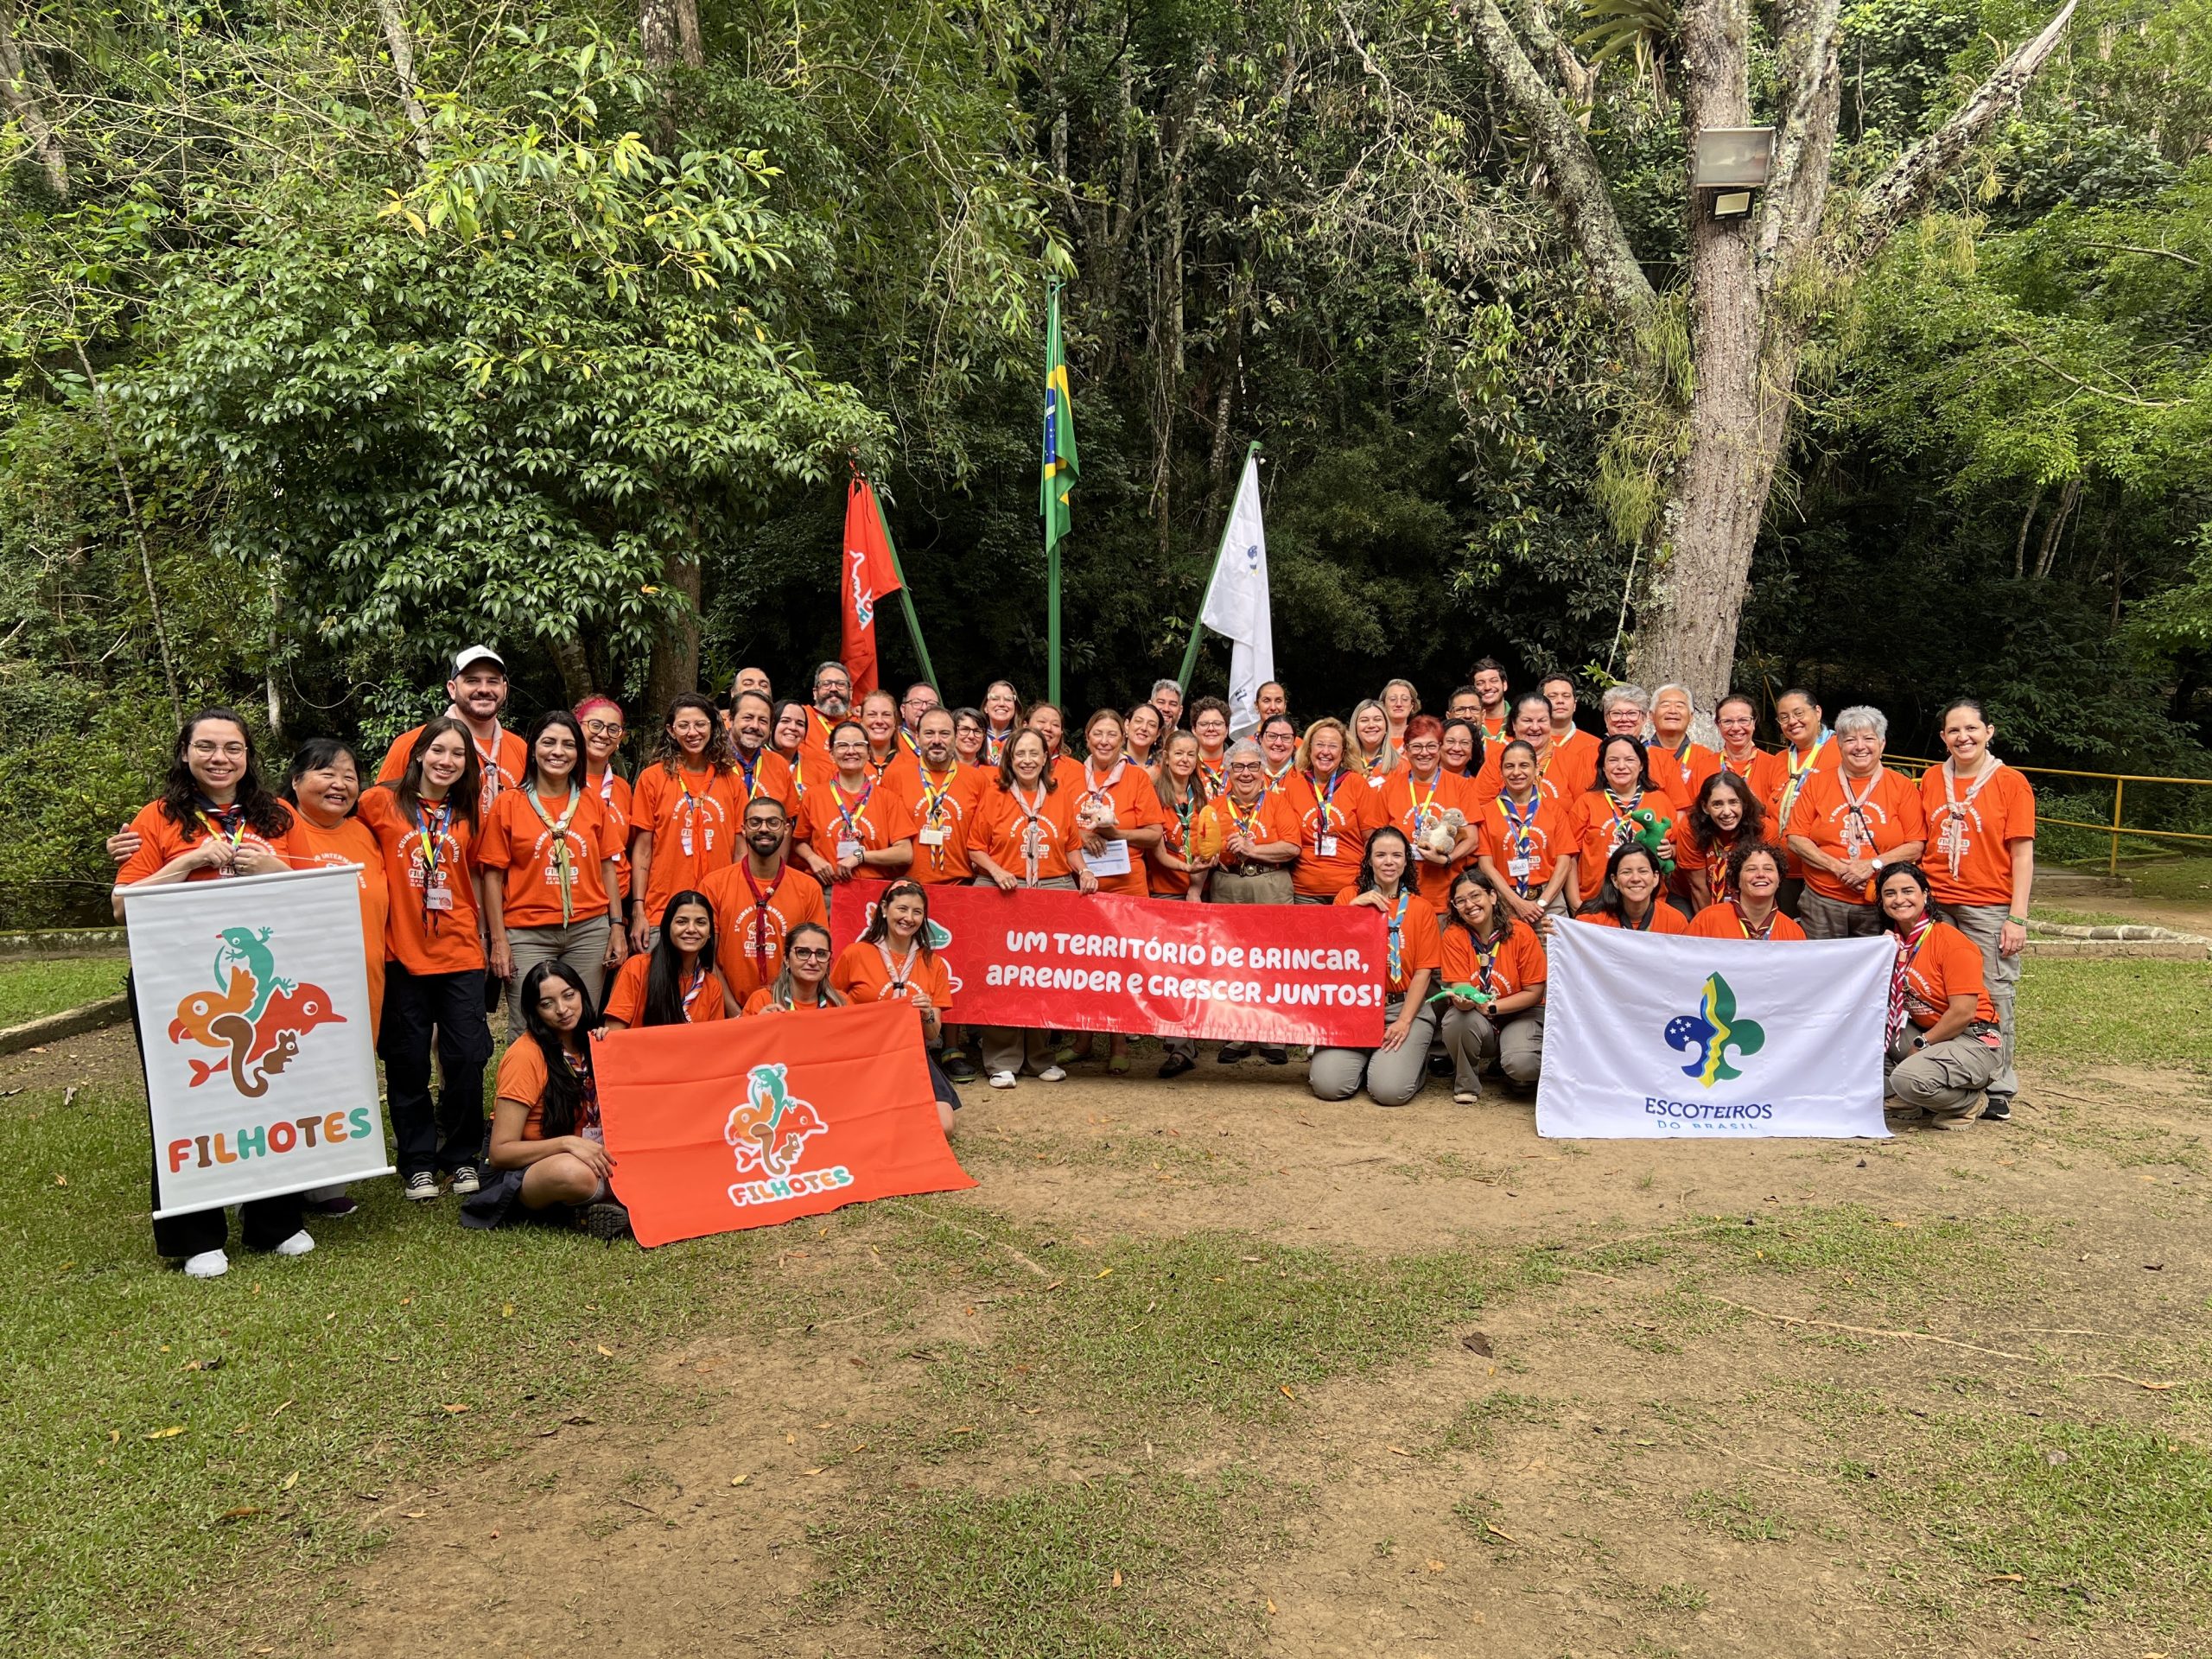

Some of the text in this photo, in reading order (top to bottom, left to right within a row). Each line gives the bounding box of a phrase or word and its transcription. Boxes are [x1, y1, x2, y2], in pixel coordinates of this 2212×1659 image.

[1266, 982, 1382, 1007] JUNTOS!
[1645, 1097, 1772, 1119] ESCOTEIROS
[1657, 1120, 1681, 1129] DO
[168, 1108, 372, 1173] FILHOTES
[732, 1168, 850, 1202] FILHOTES
